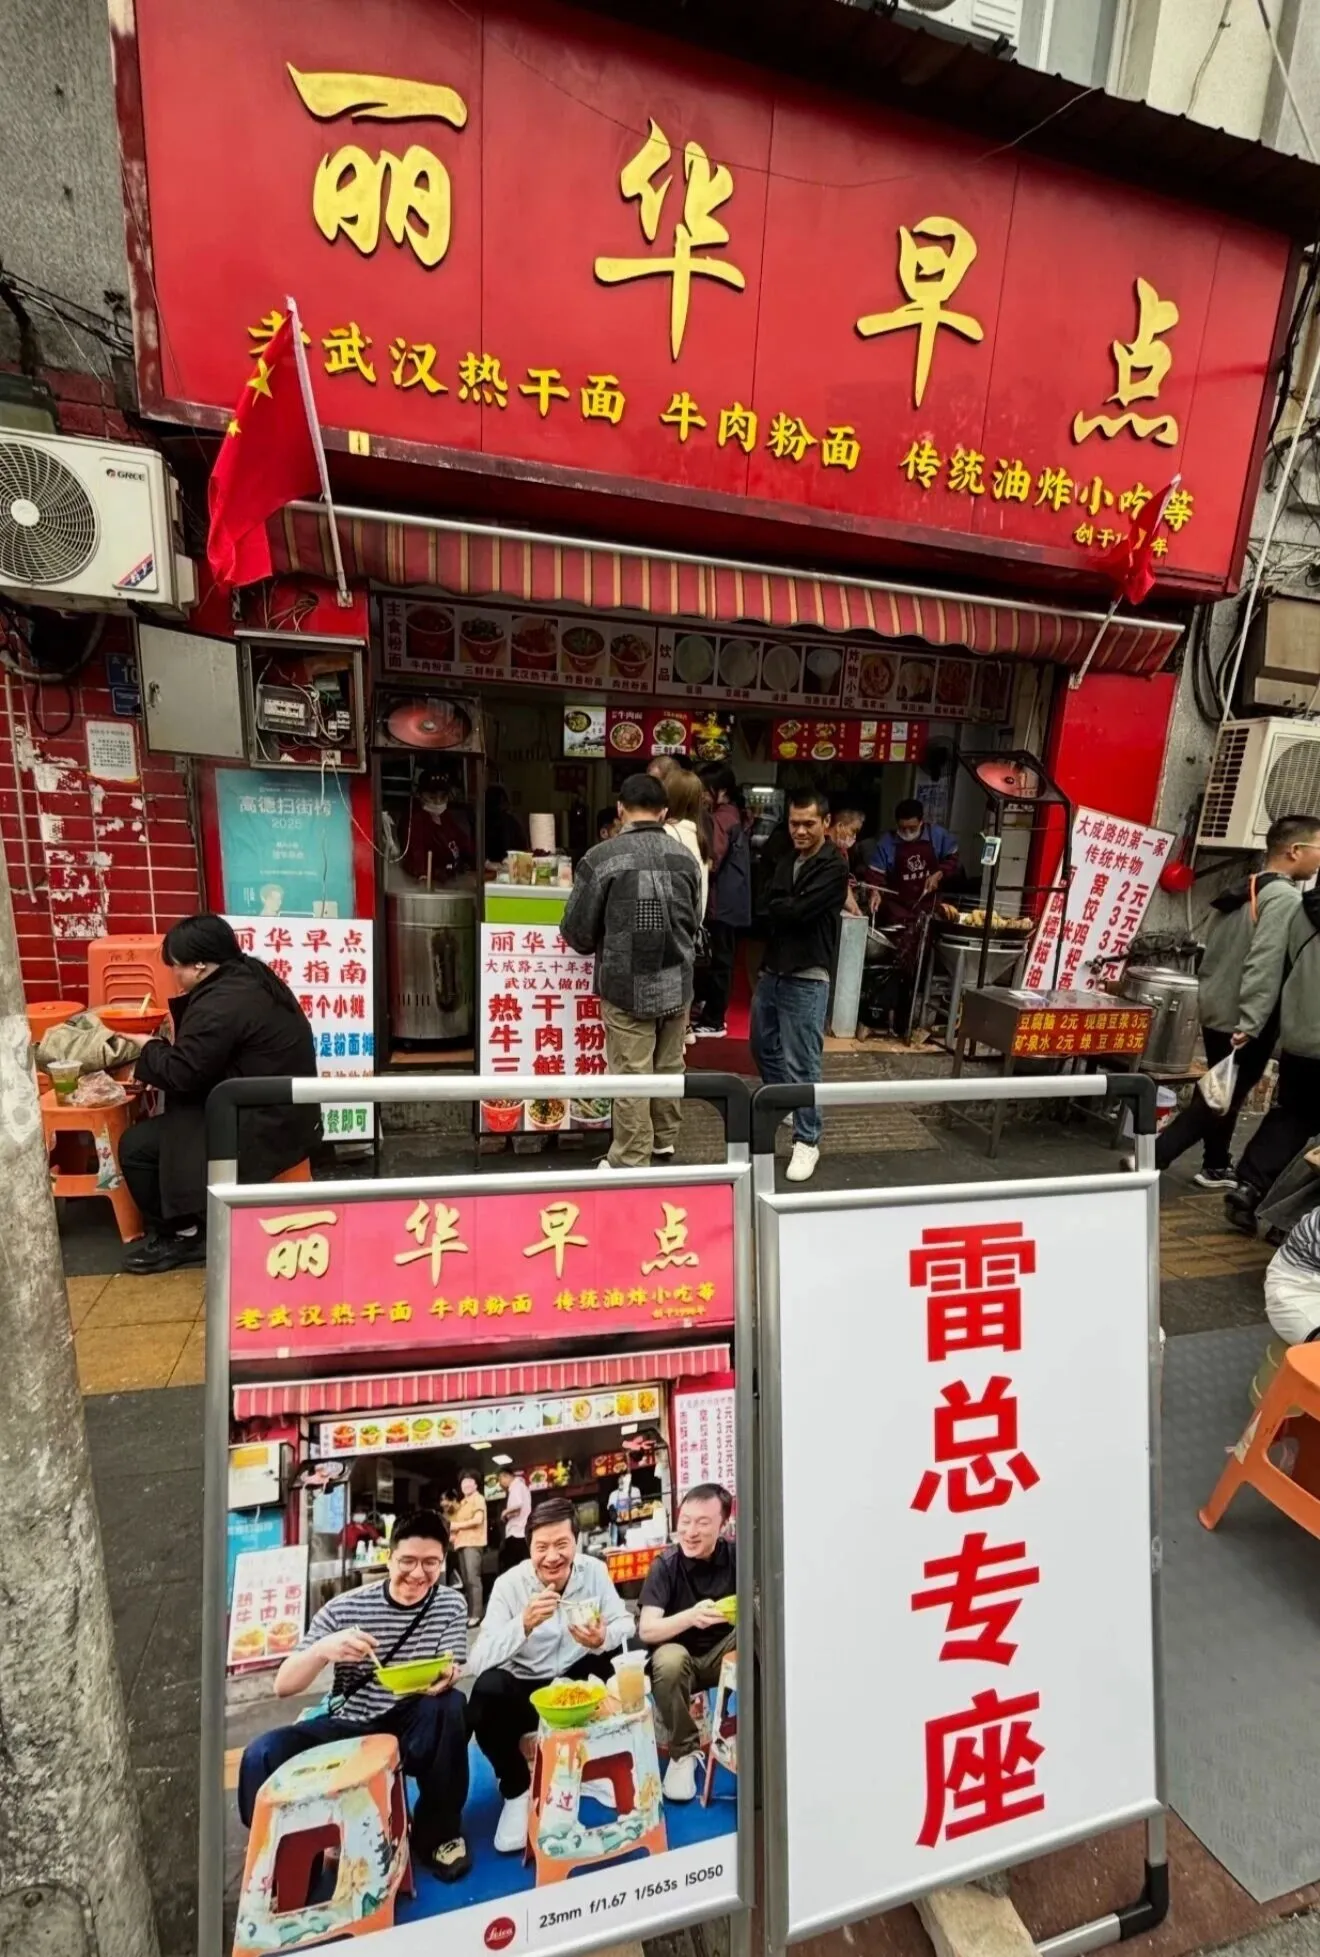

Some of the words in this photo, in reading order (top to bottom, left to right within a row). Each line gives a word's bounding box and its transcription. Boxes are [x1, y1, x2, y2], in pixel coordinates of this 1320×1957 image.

[287, 61, 1179, 446] 丽华早点
[660, 392, 861, 471] 牛肉粉面
[900, 441, 1194, 532] 传统油炸小吃等
[1076, 815, 1169, 857] 大成路的第一家
[1084, 844, 1144, 877] 传统炸物
[1117, 881, 1149, 908] 2元
[1108, 905, 1141, 933] 3元
[235, 926, 366, 954] 丽华早点
[1098, 930, 1129, 955] 3元
[486, 959, 593, 975] 大成路三十年老
[504, 977, 590, 991] 武汉人做的
[488, 993, 602, 1022] 热干面
[1060, 1014, 1079, 1030] 2元
[314, 1032, 375, 1057] 是粉面摊
[488, 1024, 605, 1053] 牛肉粉
[1014, 1034, 1051, 1051] 矿泉水
[1056, 1034, 1075, 1050] 2元
[1126, 1033, 1145, 1049] 3元
[322, 1108, 367, 1134] 餐即可
[259, 1199, 699, 1287] 丽华早点
[235, 1300, 414, 1332] 老武汉热干面
[429, 1293, 534, 1321] 牛肉粉面
[554, 1281, 716, 1312] 传统油炸小吃等
[909, 1220, 1046, 1850] 雷总专座
[539, 1908, 582, 1929] 23mm
[590, 1892, 627, 1914] f/1.67
[634, 1879, 678, 1901] 1/563s
[685, 1864, 723, 1885] ISO50
